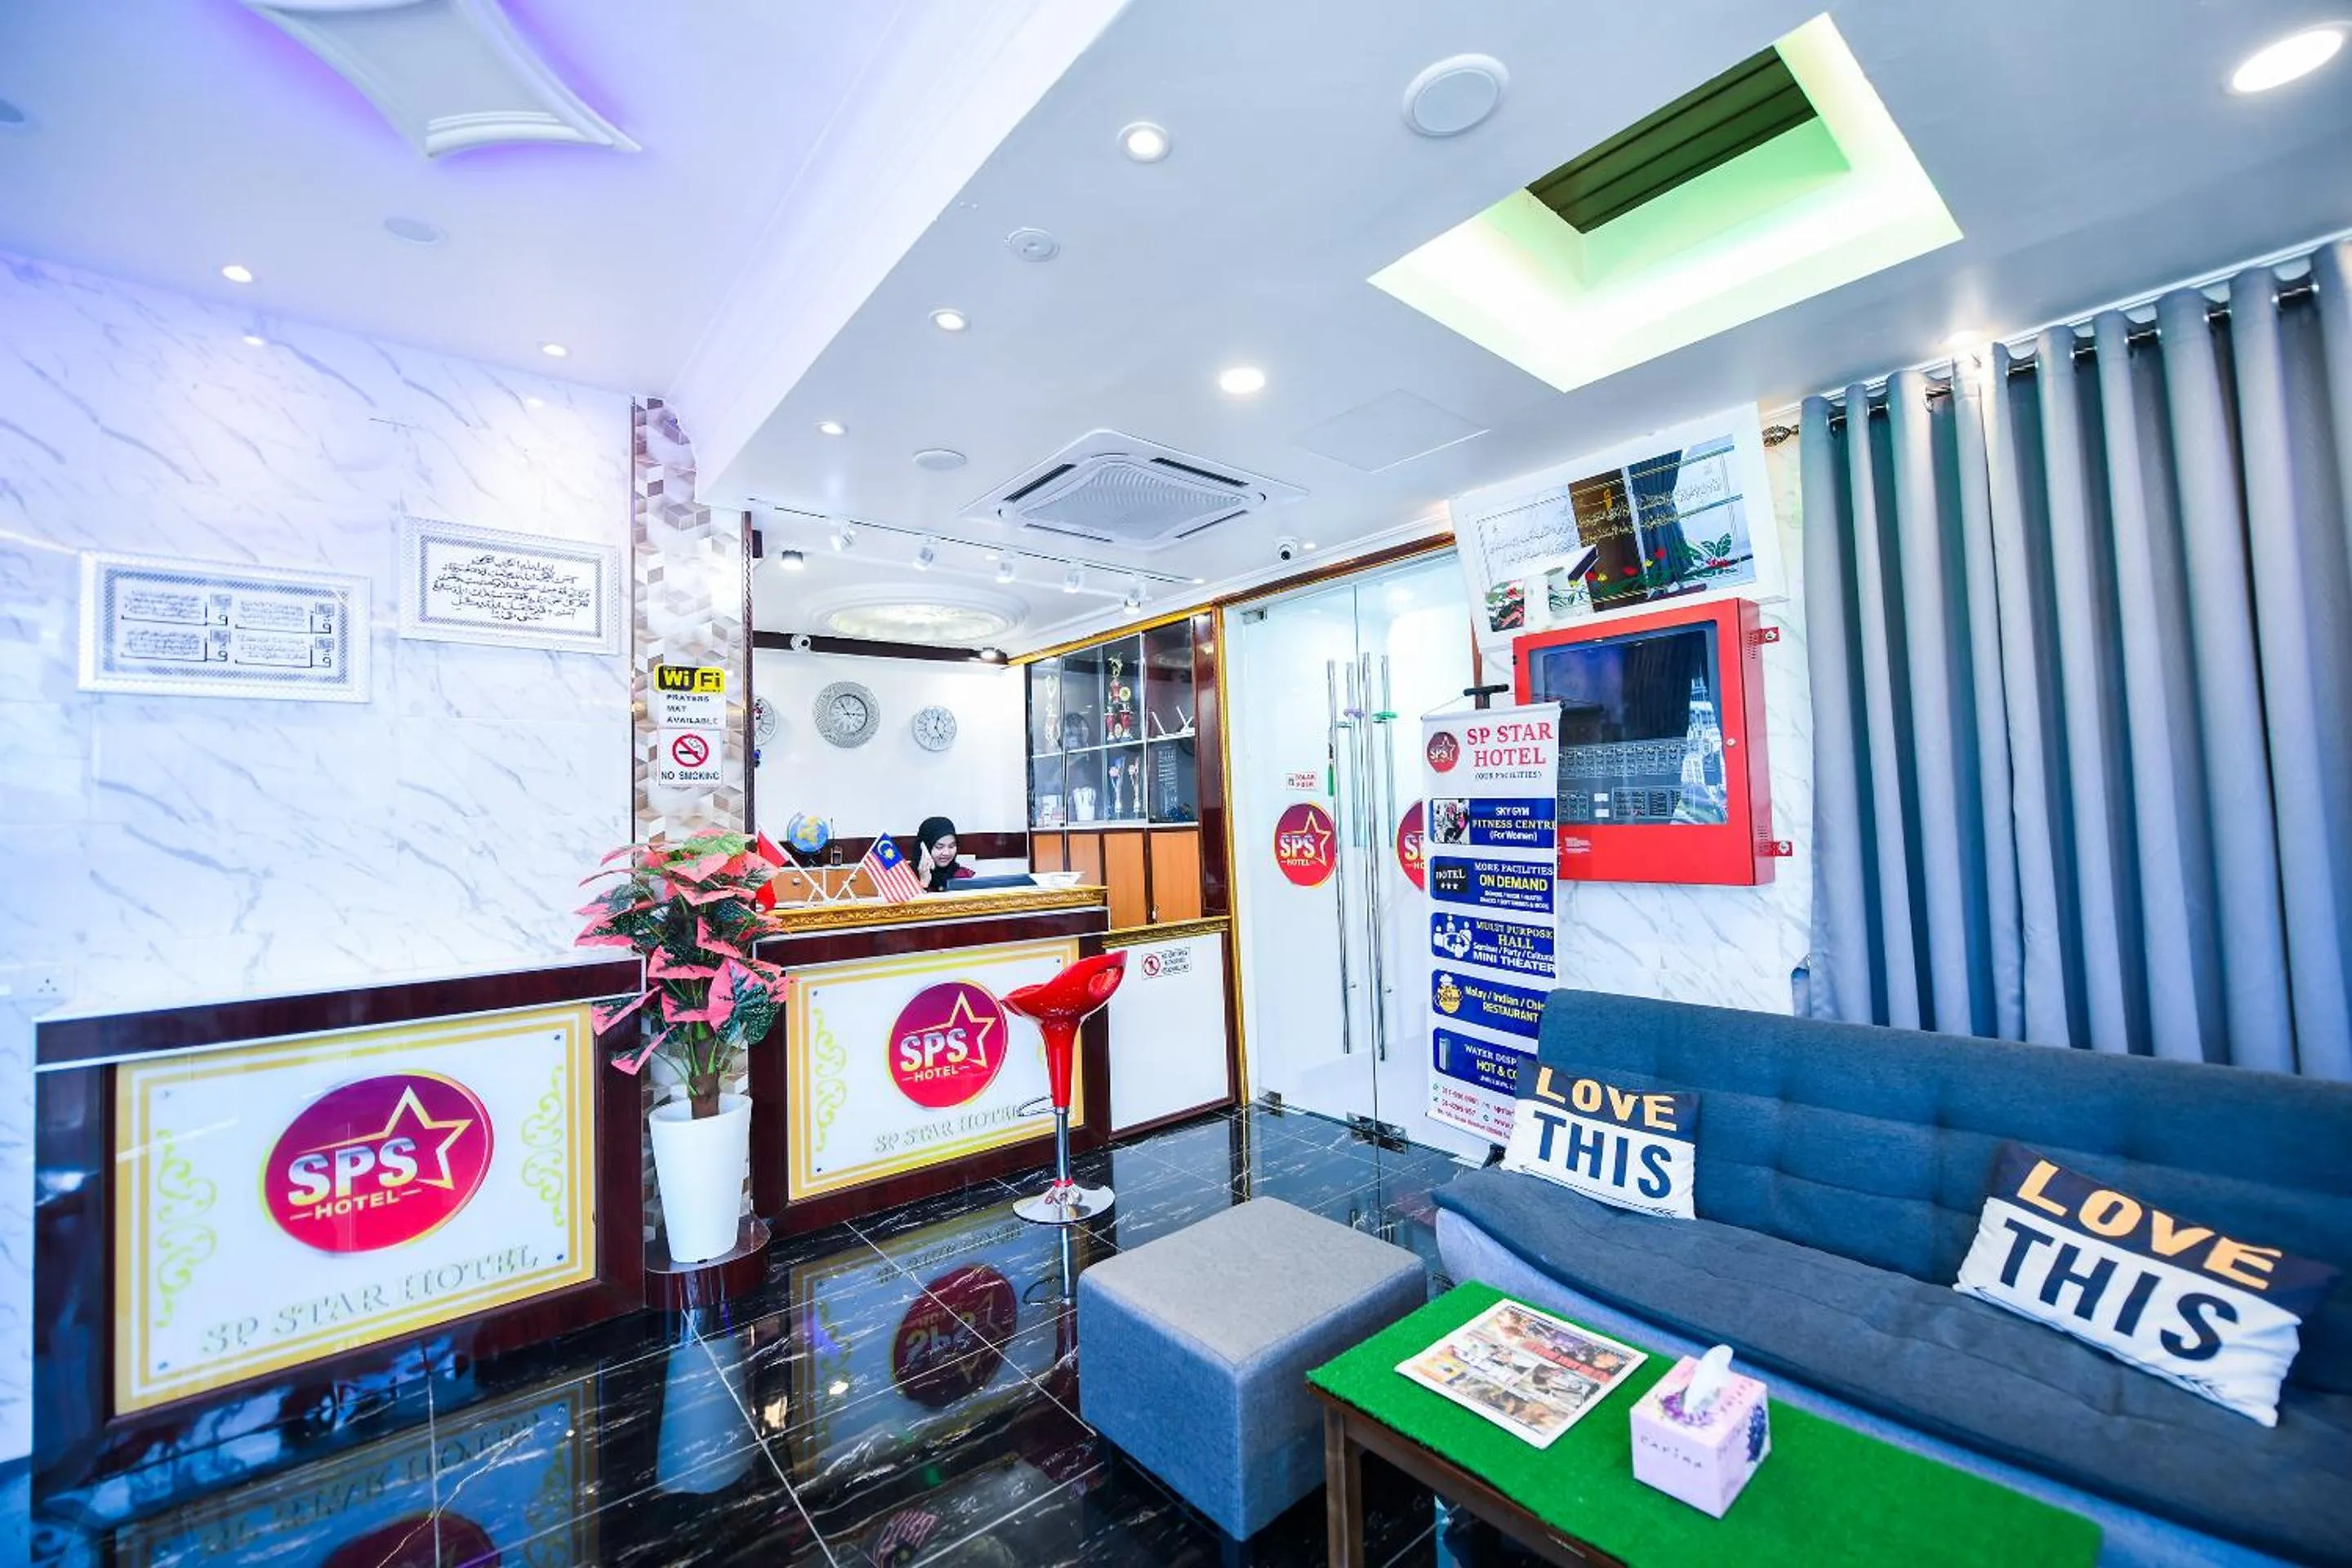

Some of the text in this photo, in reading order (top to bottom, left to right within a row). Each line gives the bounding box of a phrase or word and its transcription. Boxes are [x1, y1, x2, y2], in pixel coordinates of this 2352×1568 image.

[666, 716, 719, 725] AVAILABLE
[1467, 722, 1554, 746] SP STAR
[1474, 747, 1547, 768] HOTEL
[661, 771, 719, 781] NO SMOKING
[1512, 807, 1530, 816] GYM
[1472, 819, 1556, 830] FITNESS CENTRE
[1279, 834, 1316, 858] SPS
[1287, 858, 1310, 866] HOTEL
[1474, 862, 1553, 875] MORE FACILITIES
[1436, 869, 1466, 880] HOTEL
[1480, 875, 1548, 892] ON DEMAND
[1499, 934, 1534, 950] HALL
[1472, 951, 1556, 973] MINI THEATER
[1494, 991, 1519, 1006] Indian
[1483, 1001, 1539, 1022] RESTAURANT
[900, 1027, 969, 1072] SPS
[1463, 1044, 1494, 1060] WATER
[914, 1065, 959, 1083] HOTEL
[1477, 1059, 1495, 1074] HOT
[1497, 1065, 1505, 1078] &
[1535, 1067, 1677, 1132] LOVE
[875, 1134, 899, 1153] SP
[903, 1120, 955, 1147] STAR
[1533, 1110, 1673, 1199] THIS
[287, 1137, 419, 1207] SPS
[314, 1192, 400, 1221] HOTEL
[2016, 1160, 2283, 1290] LOVE
[2000, 1217, 2239, 1361] THIS
[201, 1244, 539, 1356] SP STAR HOTEL
